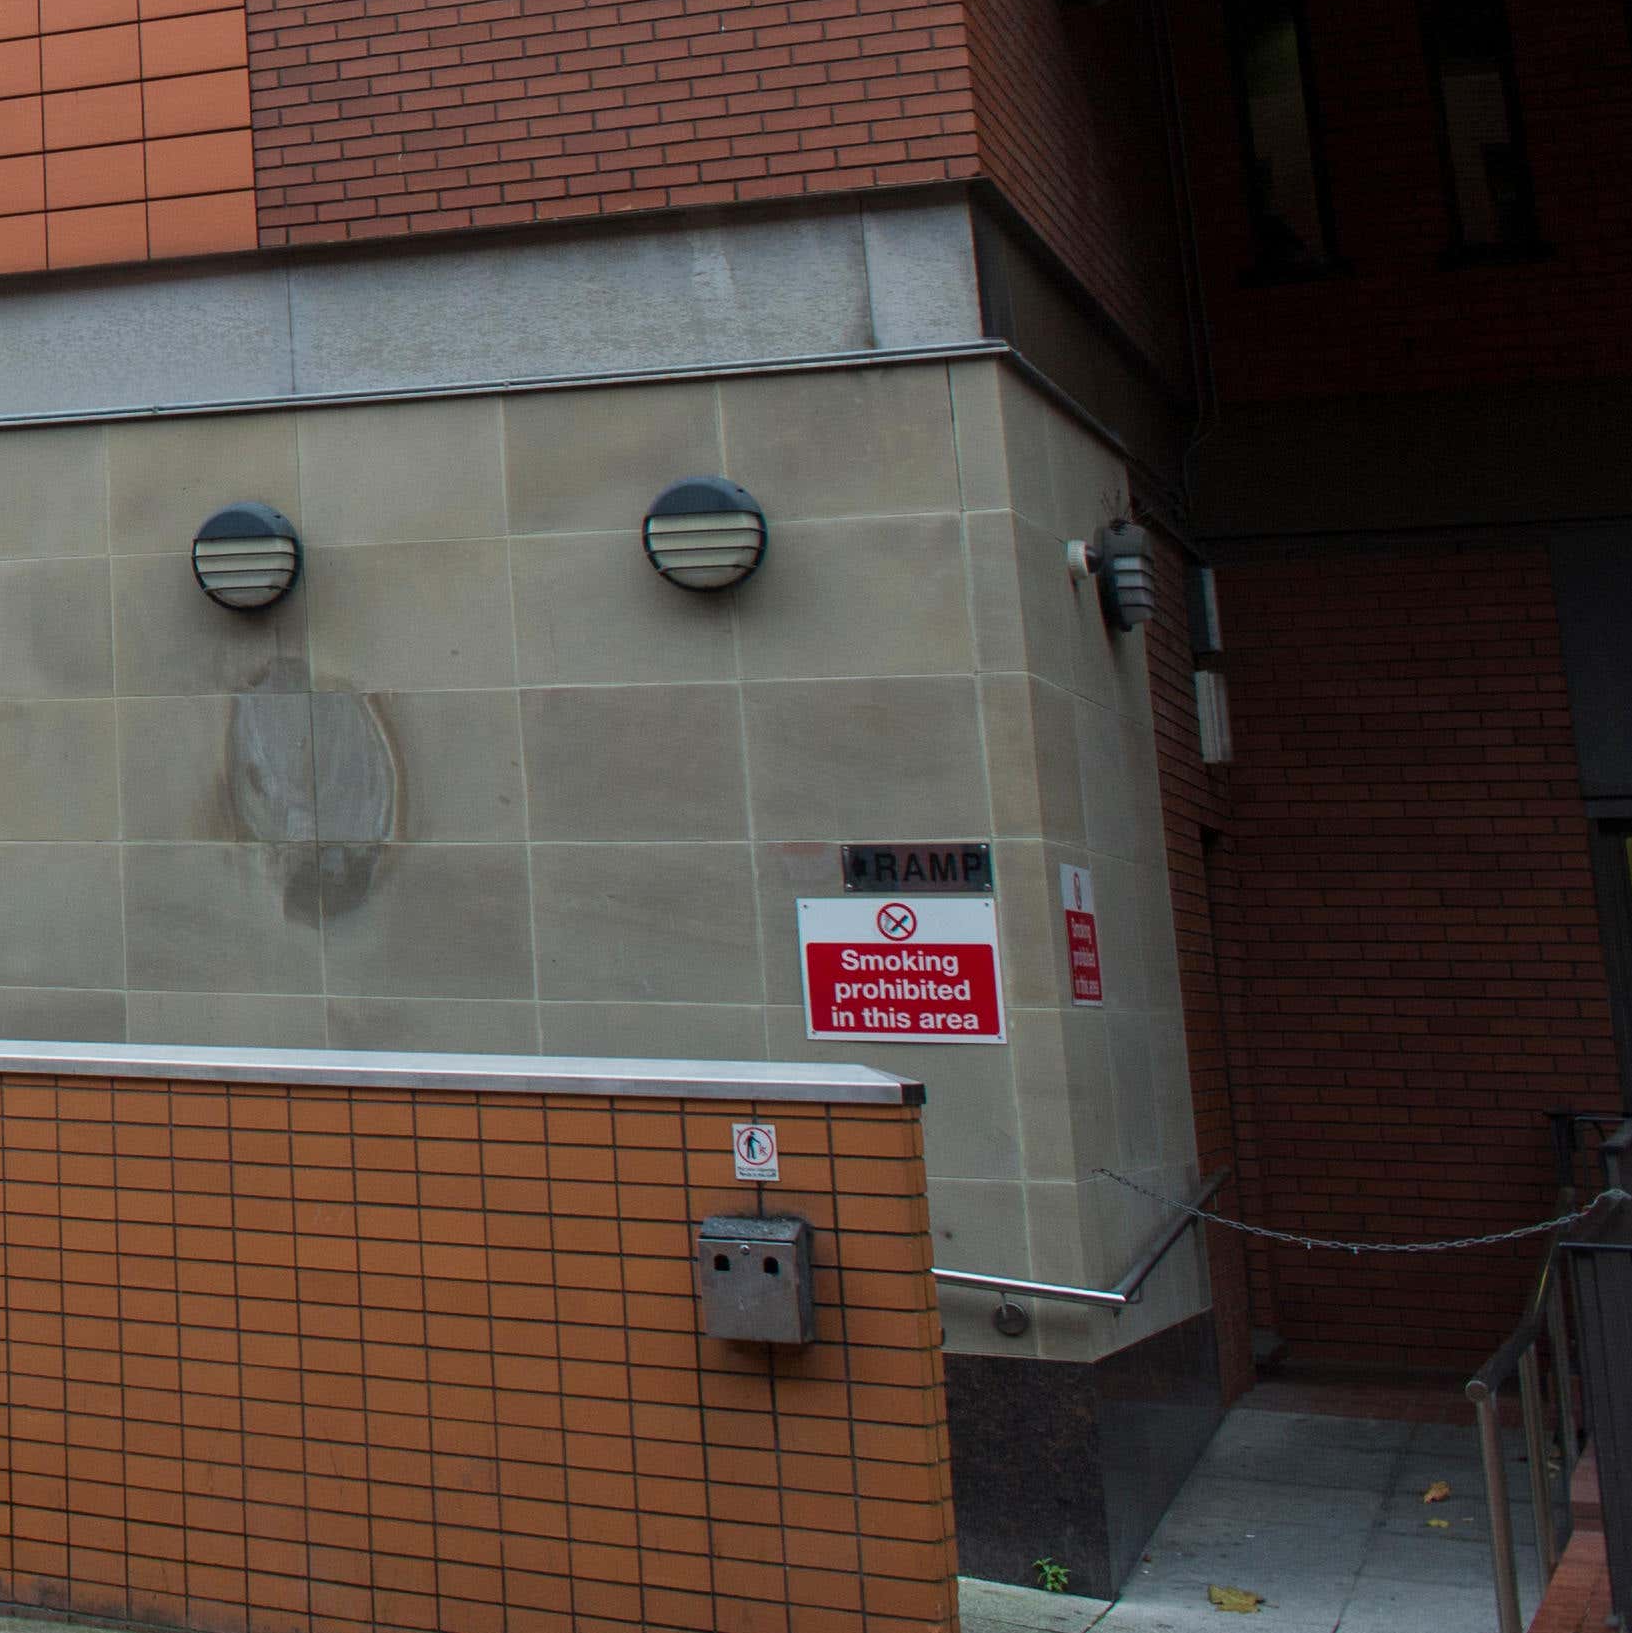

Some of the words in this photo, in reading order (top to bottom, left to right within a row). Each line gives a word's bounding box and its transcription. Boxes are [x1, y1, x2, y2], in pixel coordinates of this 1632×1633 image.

[875, 852, 982, 882] RAMP
[841, 949, 959, 976] Smoking
[834, 979, 971, 1003] prohibited
[831, 1006, 855, 1027] in
[862, 1007, 911, 1029] this
[919, 1012, 979, 1031] area
